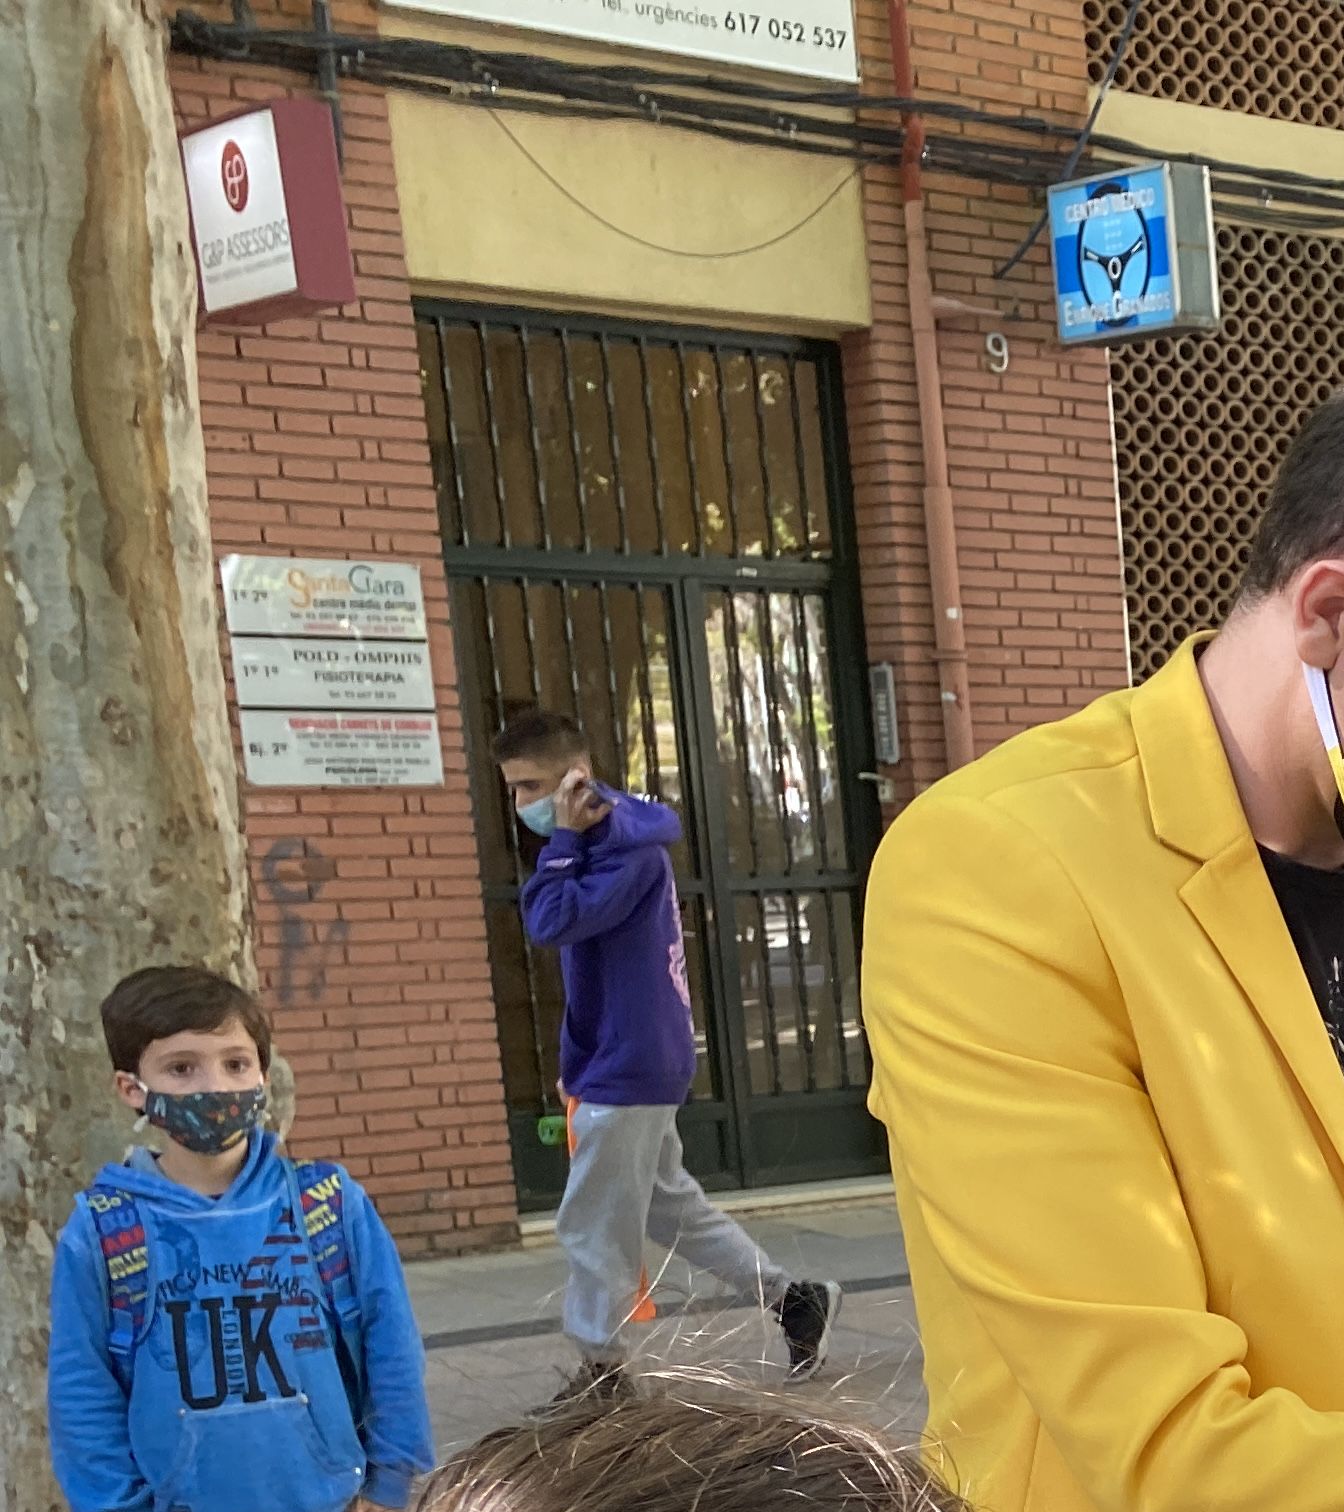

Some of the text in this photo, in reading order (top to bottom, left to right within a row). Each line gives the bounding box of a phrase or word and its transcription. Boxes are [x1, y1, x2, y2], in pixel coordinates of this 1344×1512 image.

[635, 3, 718, 28] urgències
[724, 11, 760, 34] 617
[769, 18, 804, 43] 052
[813, 26, 847, 49] 537
[227, 218, 290, 260] ASSESSORS
[986, 332, 1008, 373] 9
[165, 1292, 298, 1410] UK
[221, 1308, 246, 1396] LONDON
